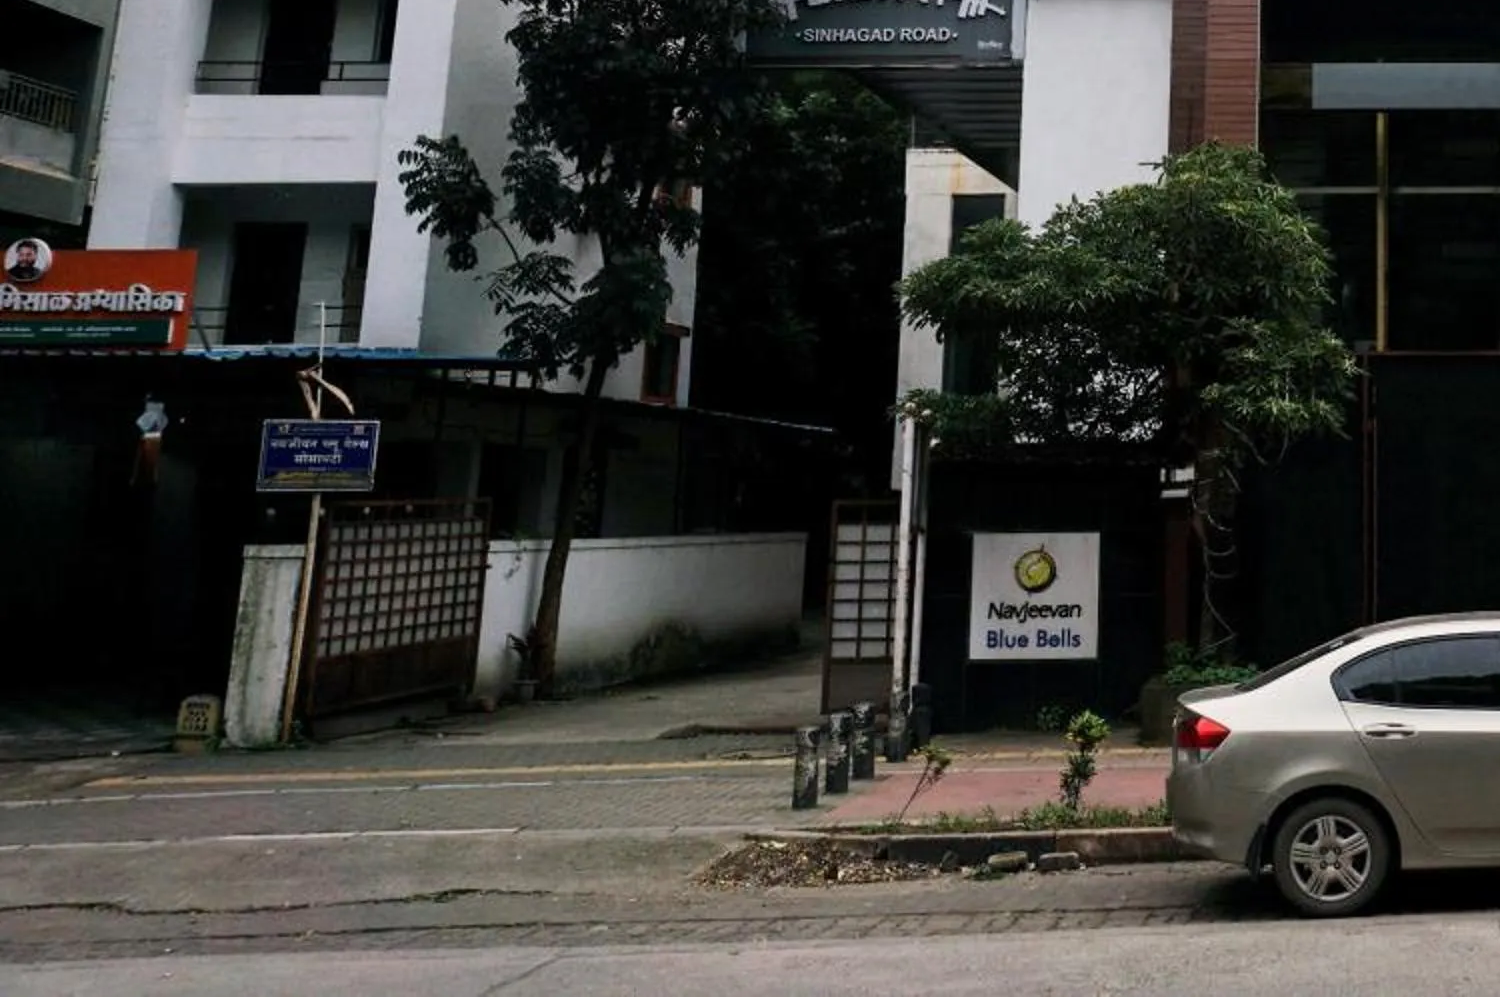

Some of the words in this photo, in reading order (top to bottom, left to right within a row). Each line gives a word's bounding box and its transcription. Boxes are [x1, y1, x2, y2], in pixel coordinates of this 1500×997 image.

[803, 27, 895, 42] SINHAGAD
[900, 27, 950, 42] ROAD
[986, 629, 1029, 648] Blue
[1036, 628, 1082, 648] Bells
